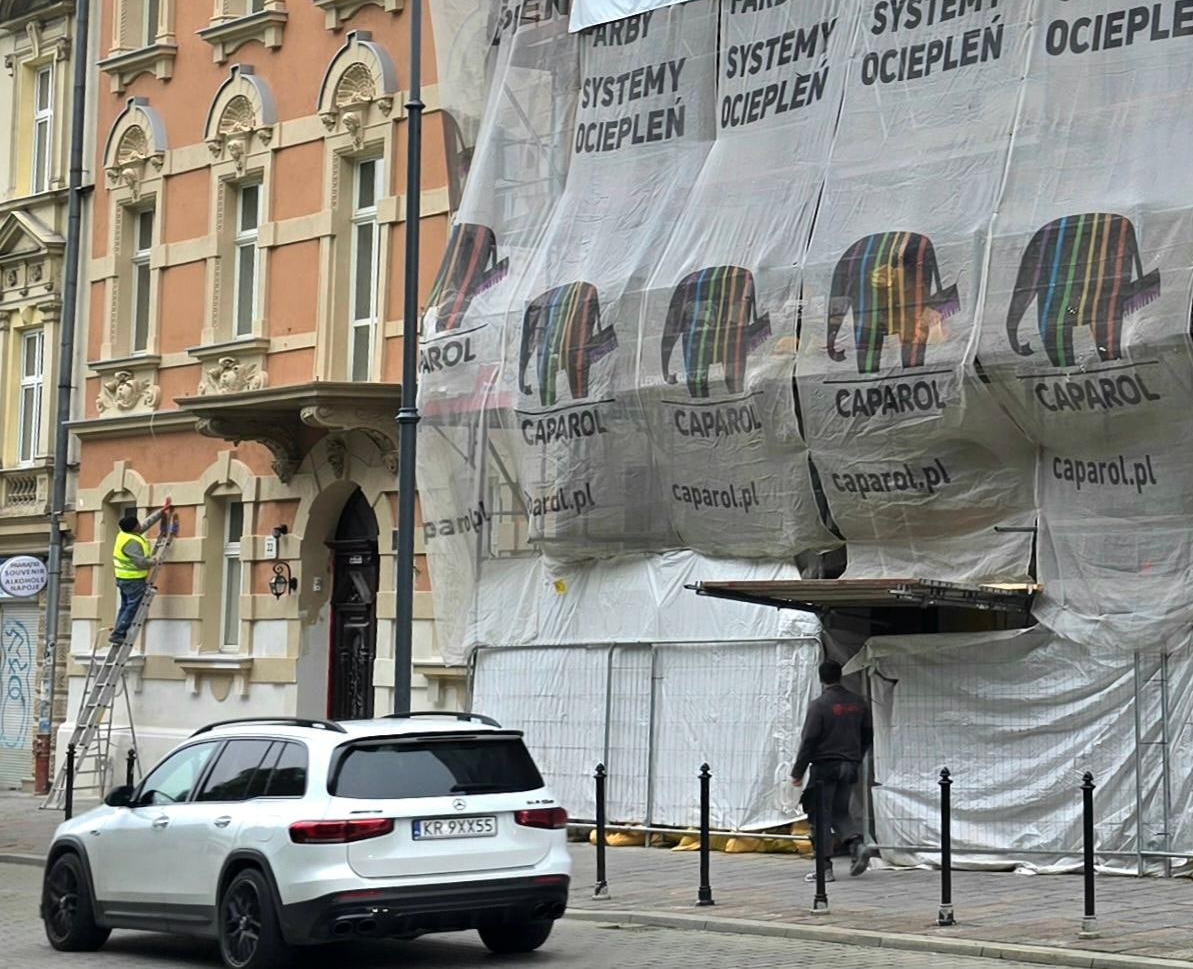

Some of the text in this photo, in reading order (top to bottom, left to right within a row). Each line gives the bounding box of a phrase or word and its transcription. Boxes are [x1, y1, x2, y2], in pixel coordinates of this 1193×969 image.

[582, 13, 653, 48] ARBY
[727, 18, 838, 80] SYSTEMY
[861, 14, 1004, 86] OCIEPLEŃ
[582, 57, 686, 109] SYSTEMY
[721, 59, 829, 129] OCIEPLEŃ
[575, 97, 686, 154] OCIEPLEŃ
[835, 380, 946, 419] CAPAROL
[1034, 373, 1160, 412] CAPAROL
[521, 409, 607, 446] CAPAROL
[674, 405, 762, 437] CAPAROL
[831, 458, 951, 499] caparol.pl
[1053, 455, 1157, 494] caparol.pl
[672, 481, 759, 513] caparol.pl
[423, 818, 493, 835] KR 9XX55
